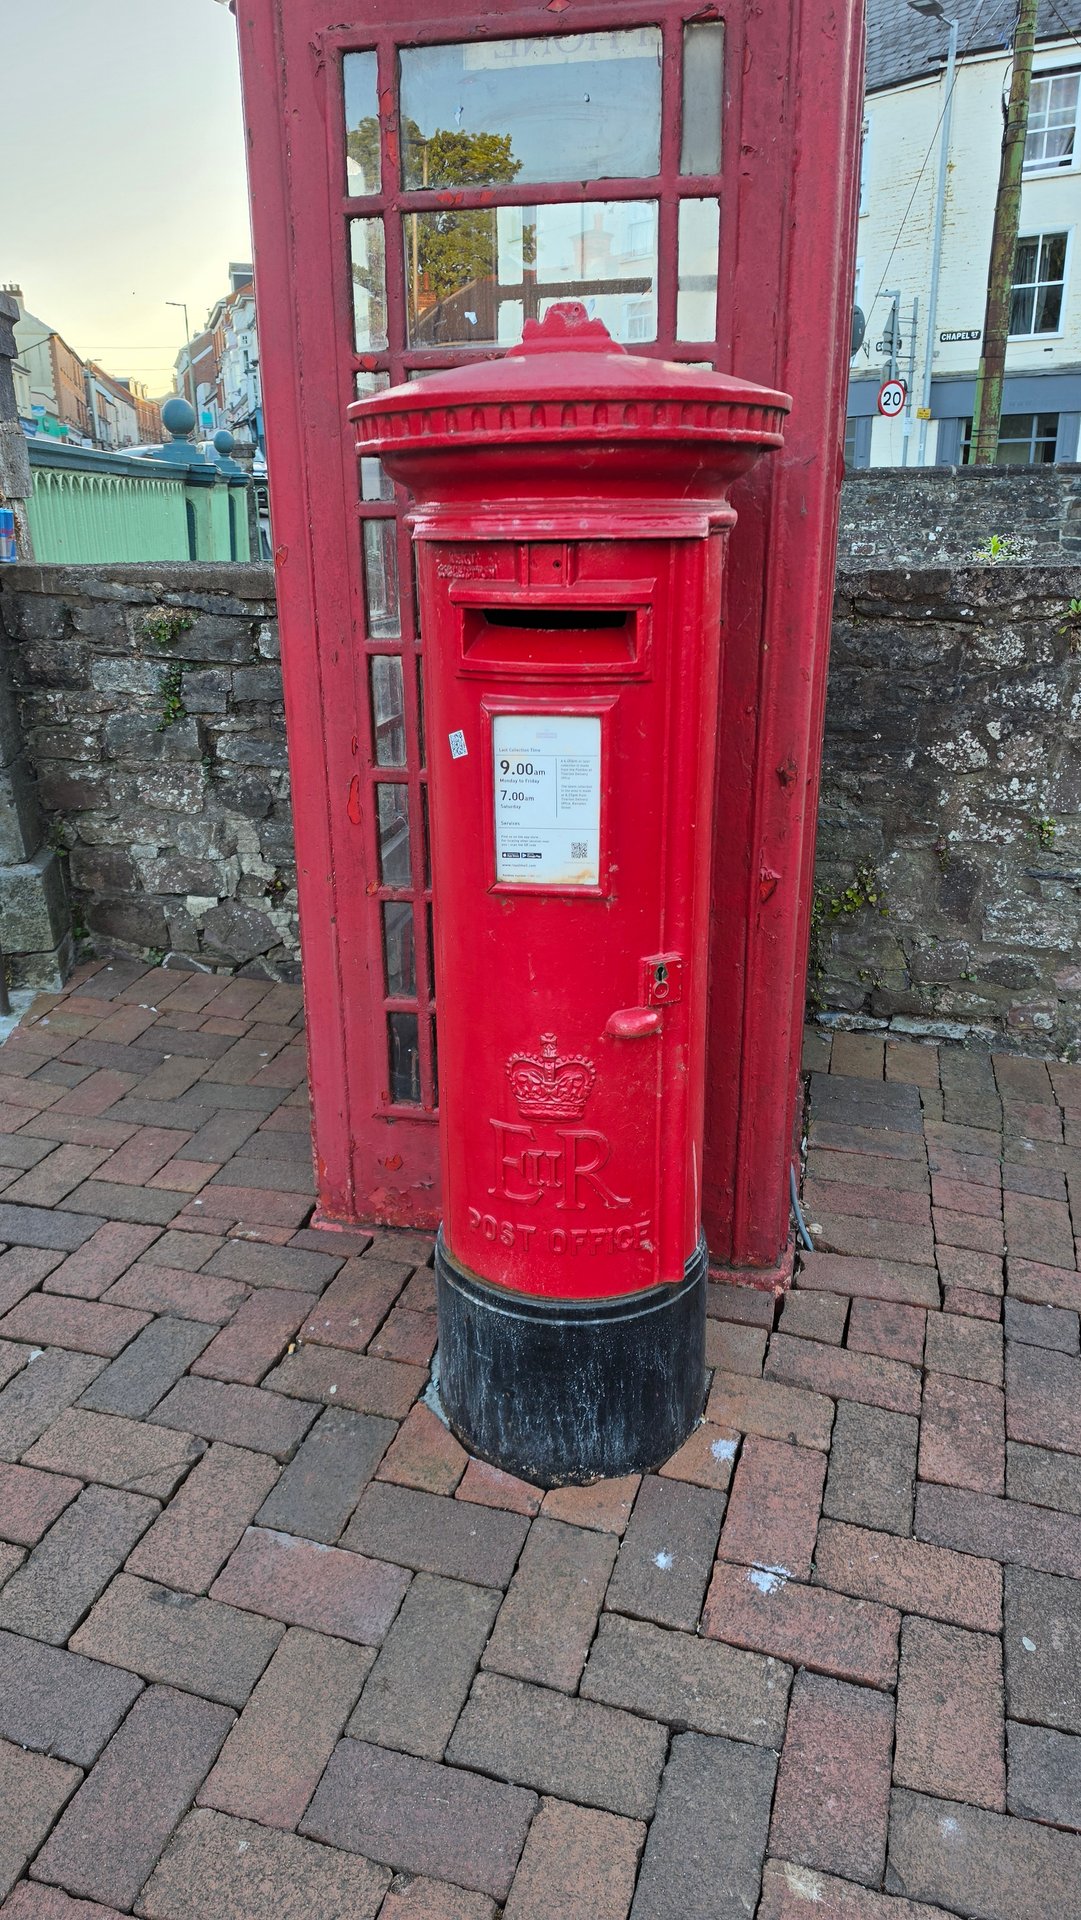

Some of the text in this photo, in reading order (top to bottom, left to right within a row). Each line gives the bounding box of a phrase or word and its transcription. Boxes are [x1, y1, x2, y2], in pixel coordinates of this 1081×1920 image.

[941, 331, 979, 341] CHAPEL ST
[883, 391, 901, 406] 20
[500, 760, 546, 776] 9.00am
[500, 790, 535, 801] 7.00am
[467, 1206, 654, 1256] POST OFFICE
